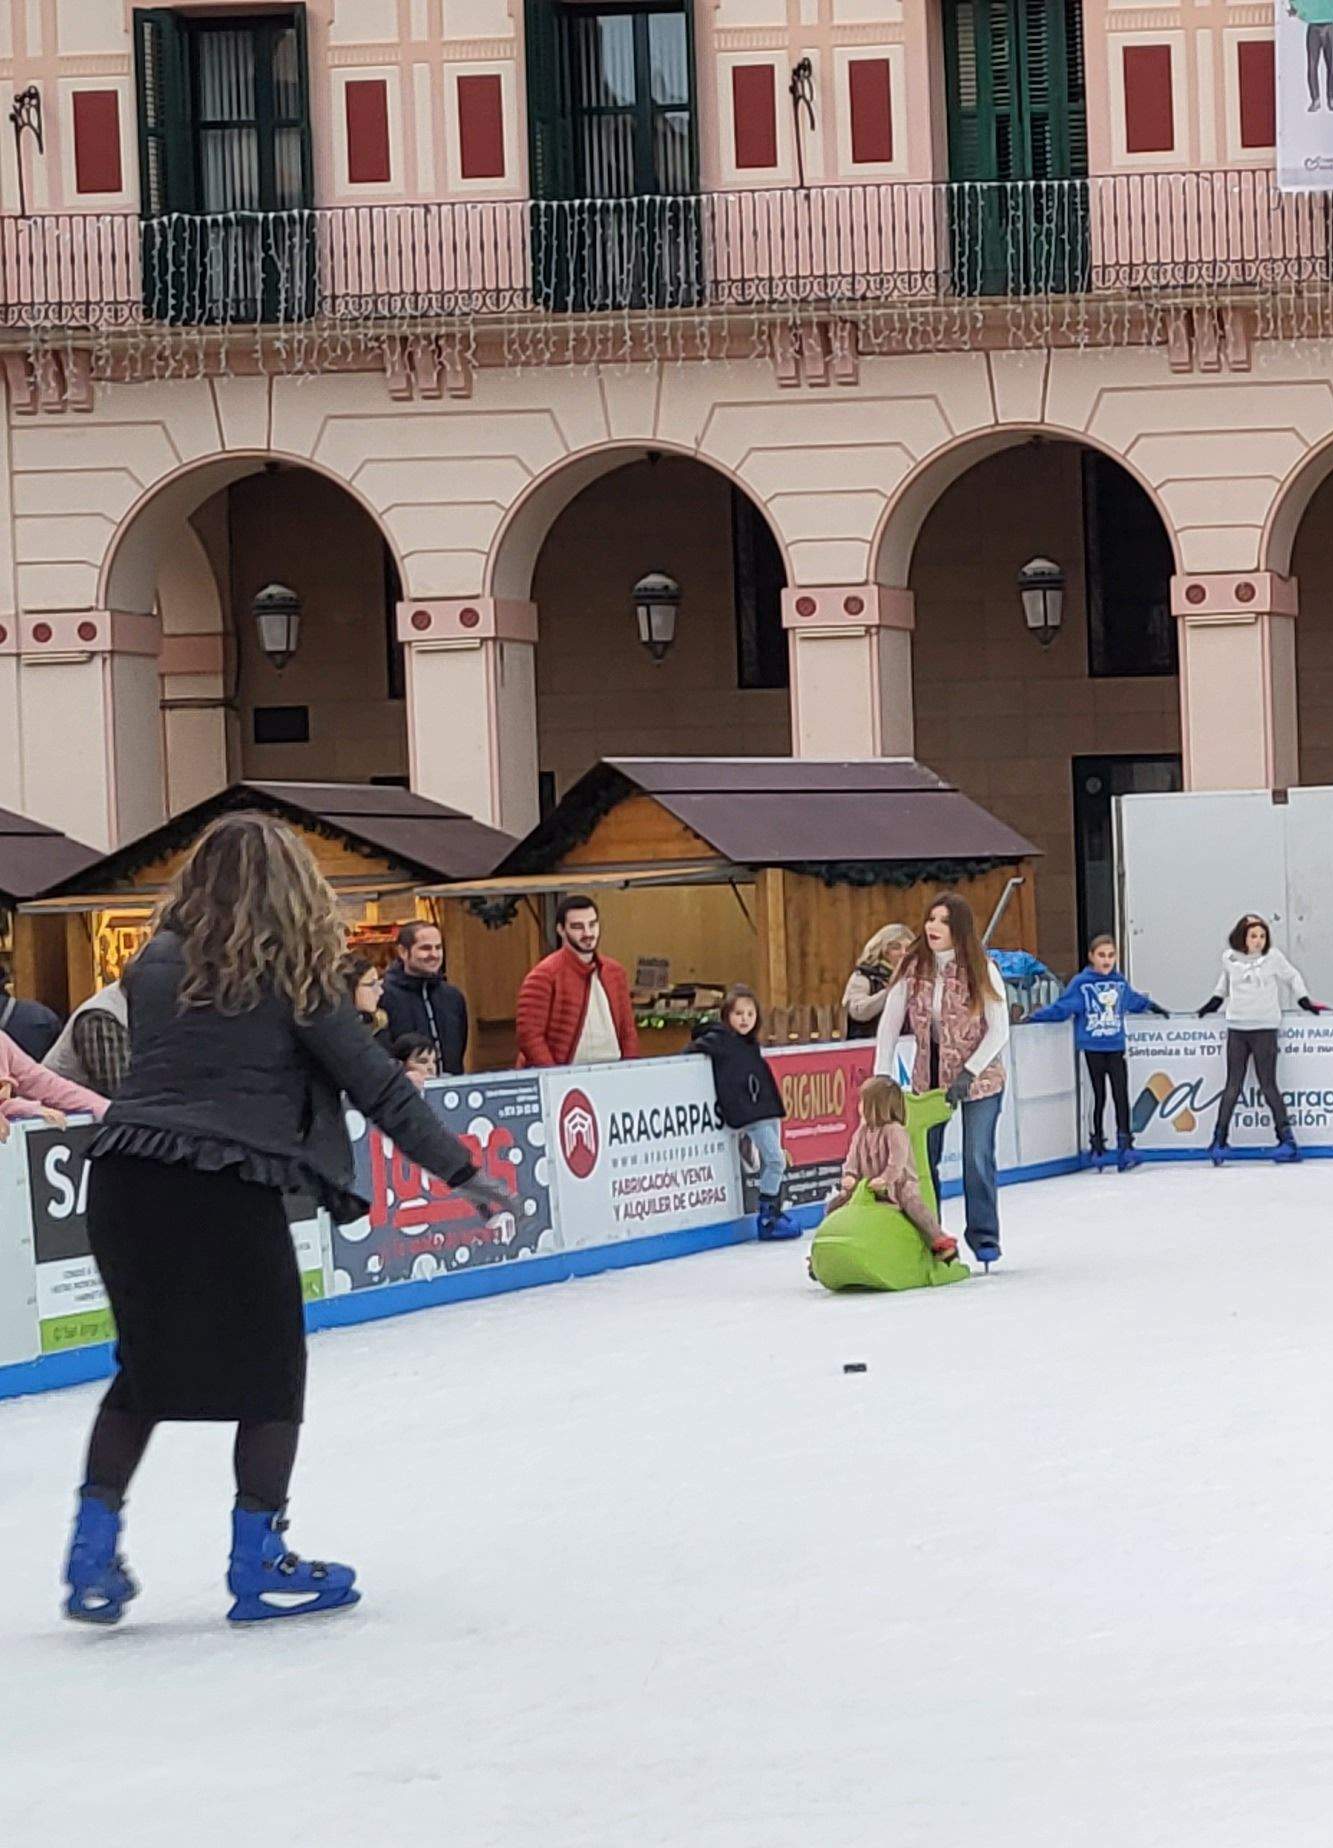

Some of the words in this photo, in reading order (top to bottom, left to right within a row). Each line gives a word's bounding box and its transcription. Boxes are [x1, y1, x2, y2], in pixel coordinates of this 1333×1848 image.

[1199, 1044, 1222, 1055] TDT
[608, 1101, 725, 1147] ARACARPAS
[681, 1165, 714, 1186] VENTA
[613, 1205, 621, 1223] Y
[623, 1195, 672, 1221] ALQUILER
[673, 1193, 687, 1211] DE
[688, 1186, 727, 1208] CARPAS
